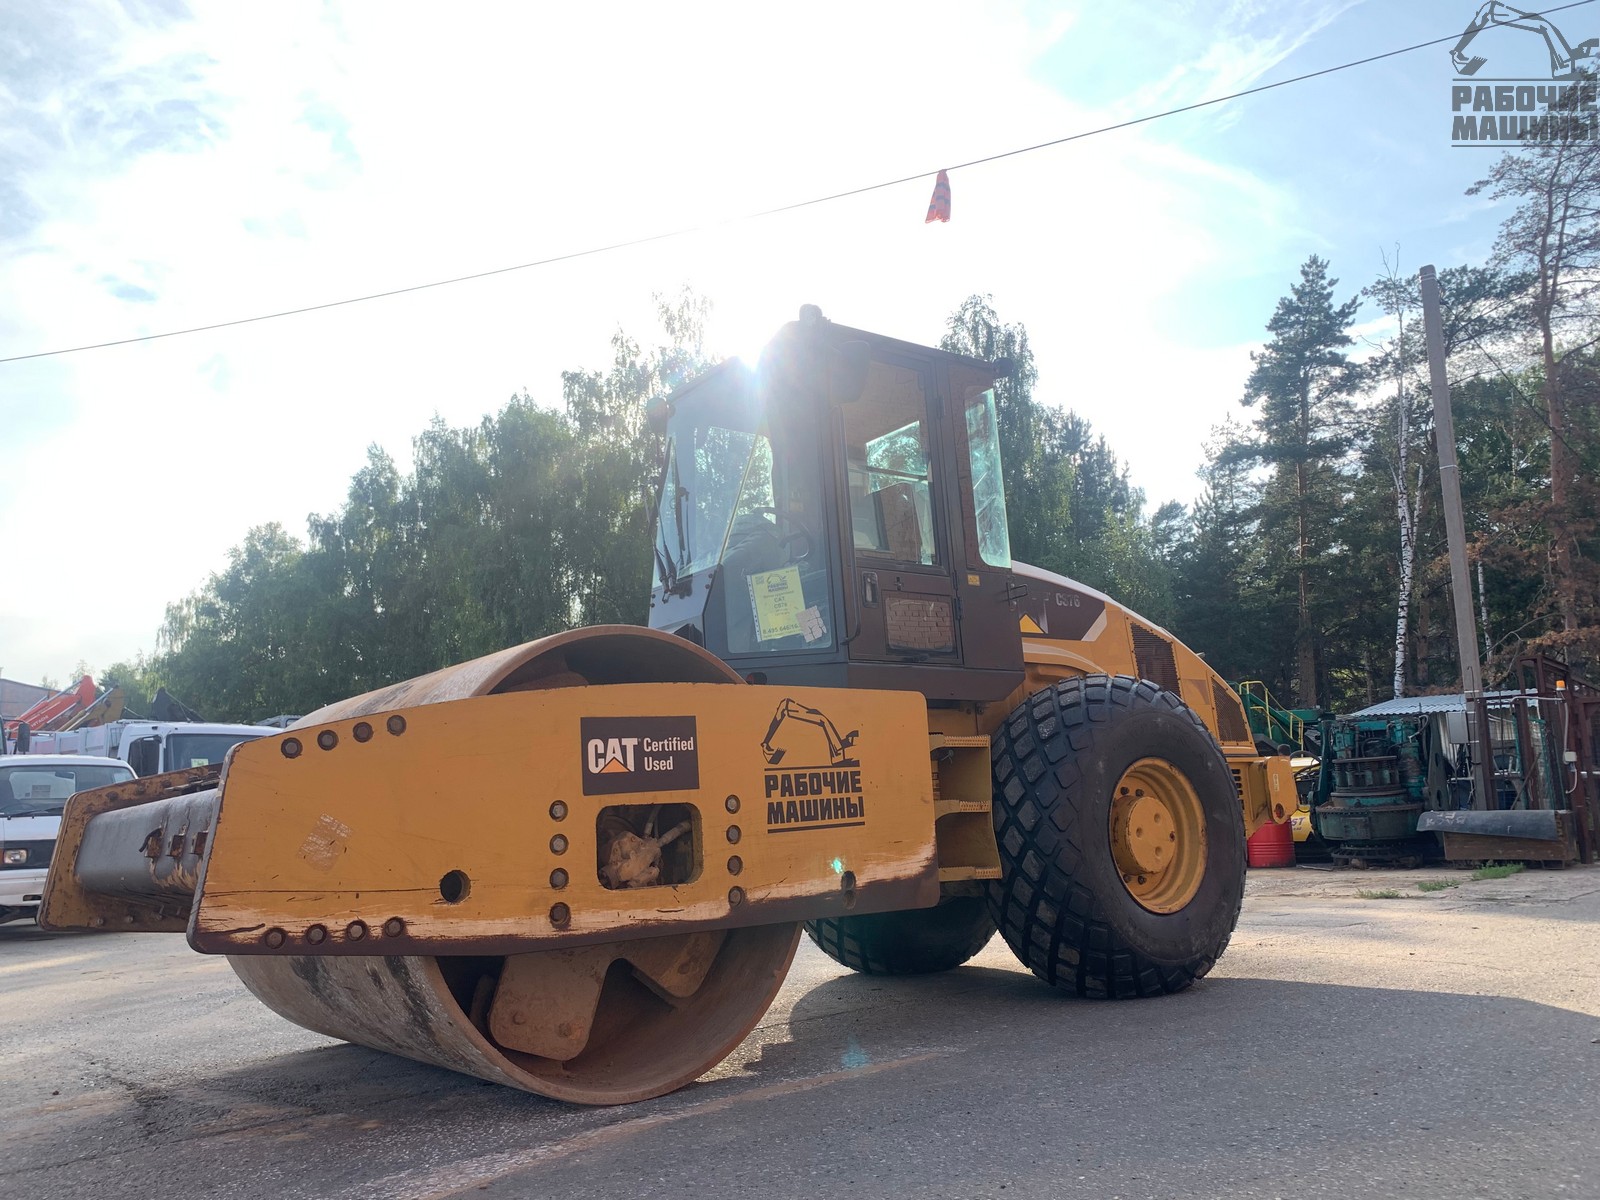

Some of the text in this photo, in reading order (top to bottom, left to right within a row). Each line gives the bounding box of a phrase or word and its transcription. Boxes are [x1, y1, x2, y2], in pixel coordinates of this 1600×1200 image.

[587, 737, 694, 774] CAT Certified
[644, 756, 674, 771] Used
[764, 770, 862, 798] РАБОЧИЕ
[767, 796, 865, 824] МАШИНЫ
